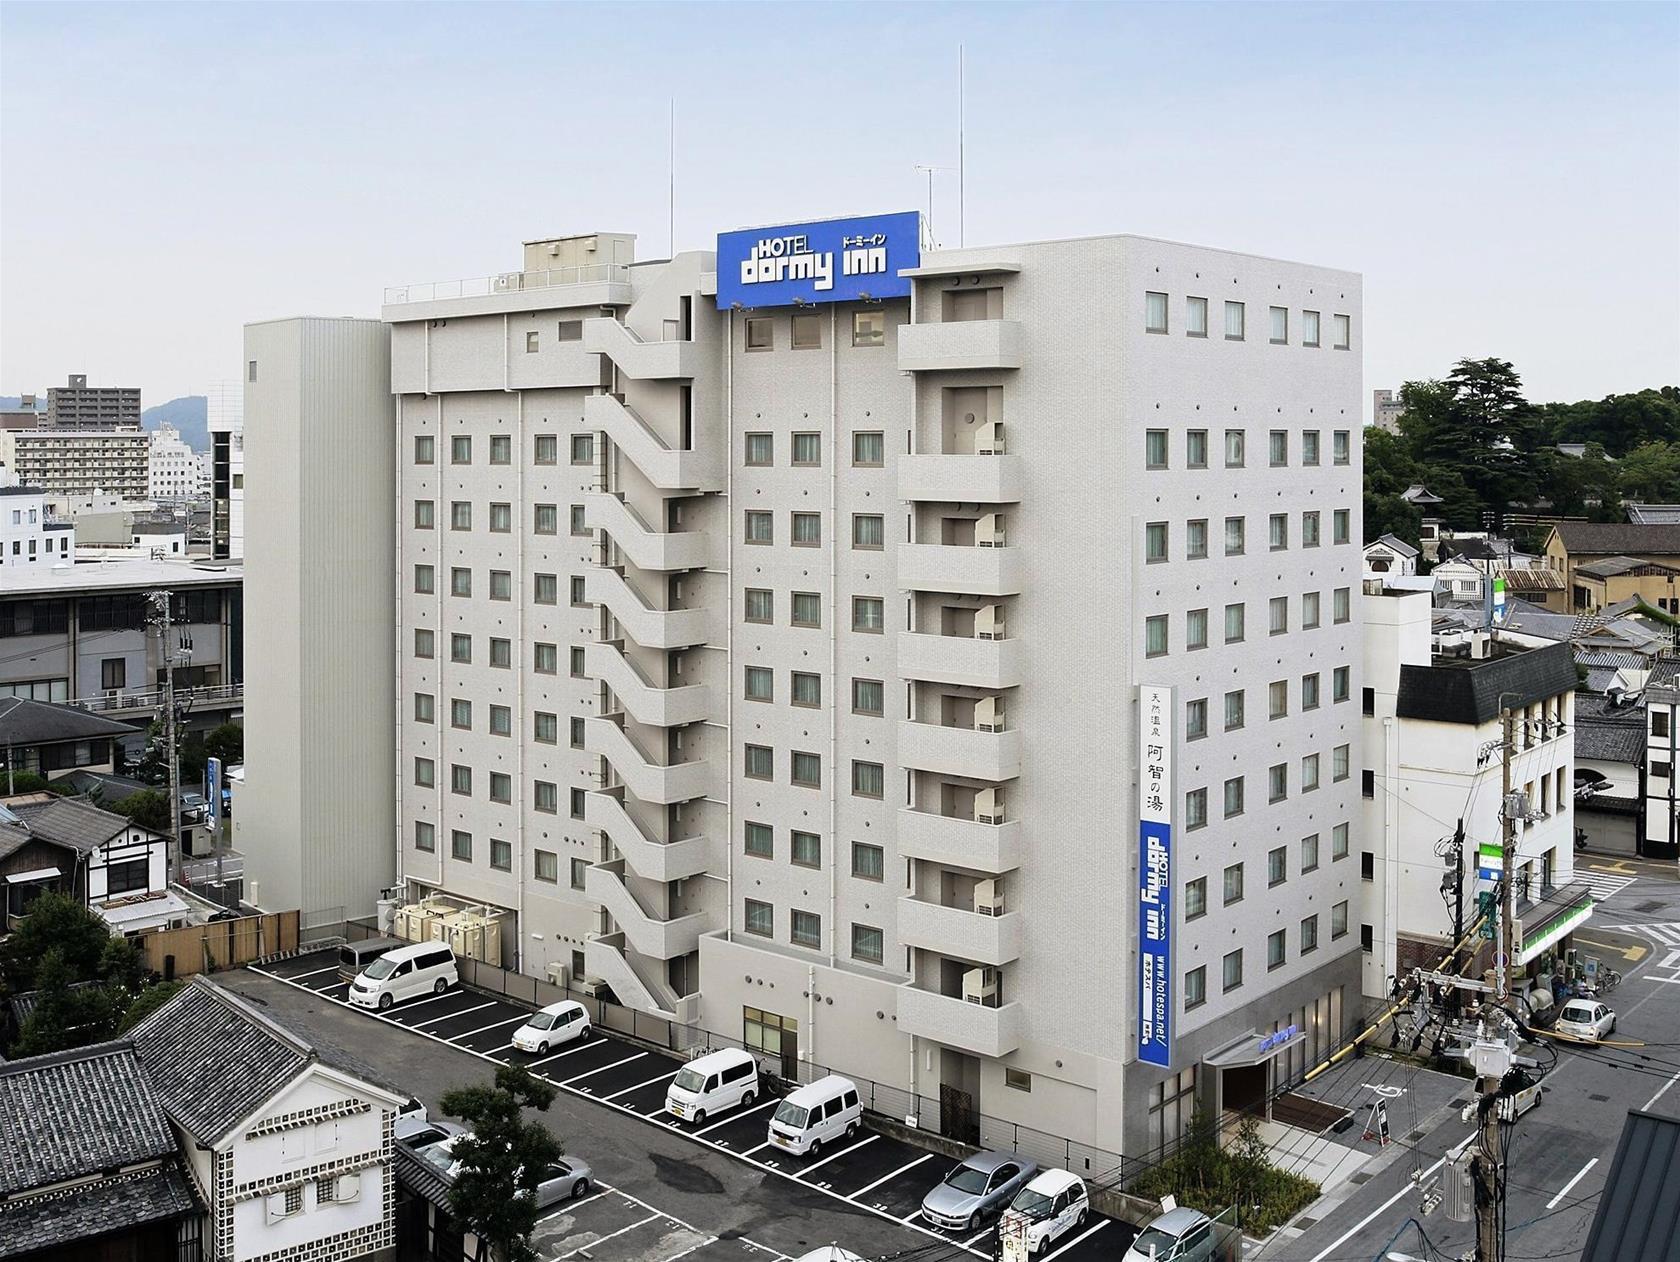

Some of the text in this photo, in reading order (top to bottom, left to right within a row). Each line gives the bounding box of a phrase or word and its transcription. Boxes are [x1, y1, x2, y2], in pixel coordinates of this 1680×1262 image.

[759, 235, 814, 257] HOTEL
[843, 235, 885, 248] ドーミーイン
[741, 247, 886, 290] dormy inn
[1151, 693, 1161, 737] 天然温泉
[1147, 744, 1164, 812] 阿智の湯
[1141, 836, 1165, 940] dormy inn
[1159, 852, 1168, 888] HOTEL
[1156, 955, 1167, 1047] www.hotespa.net/
